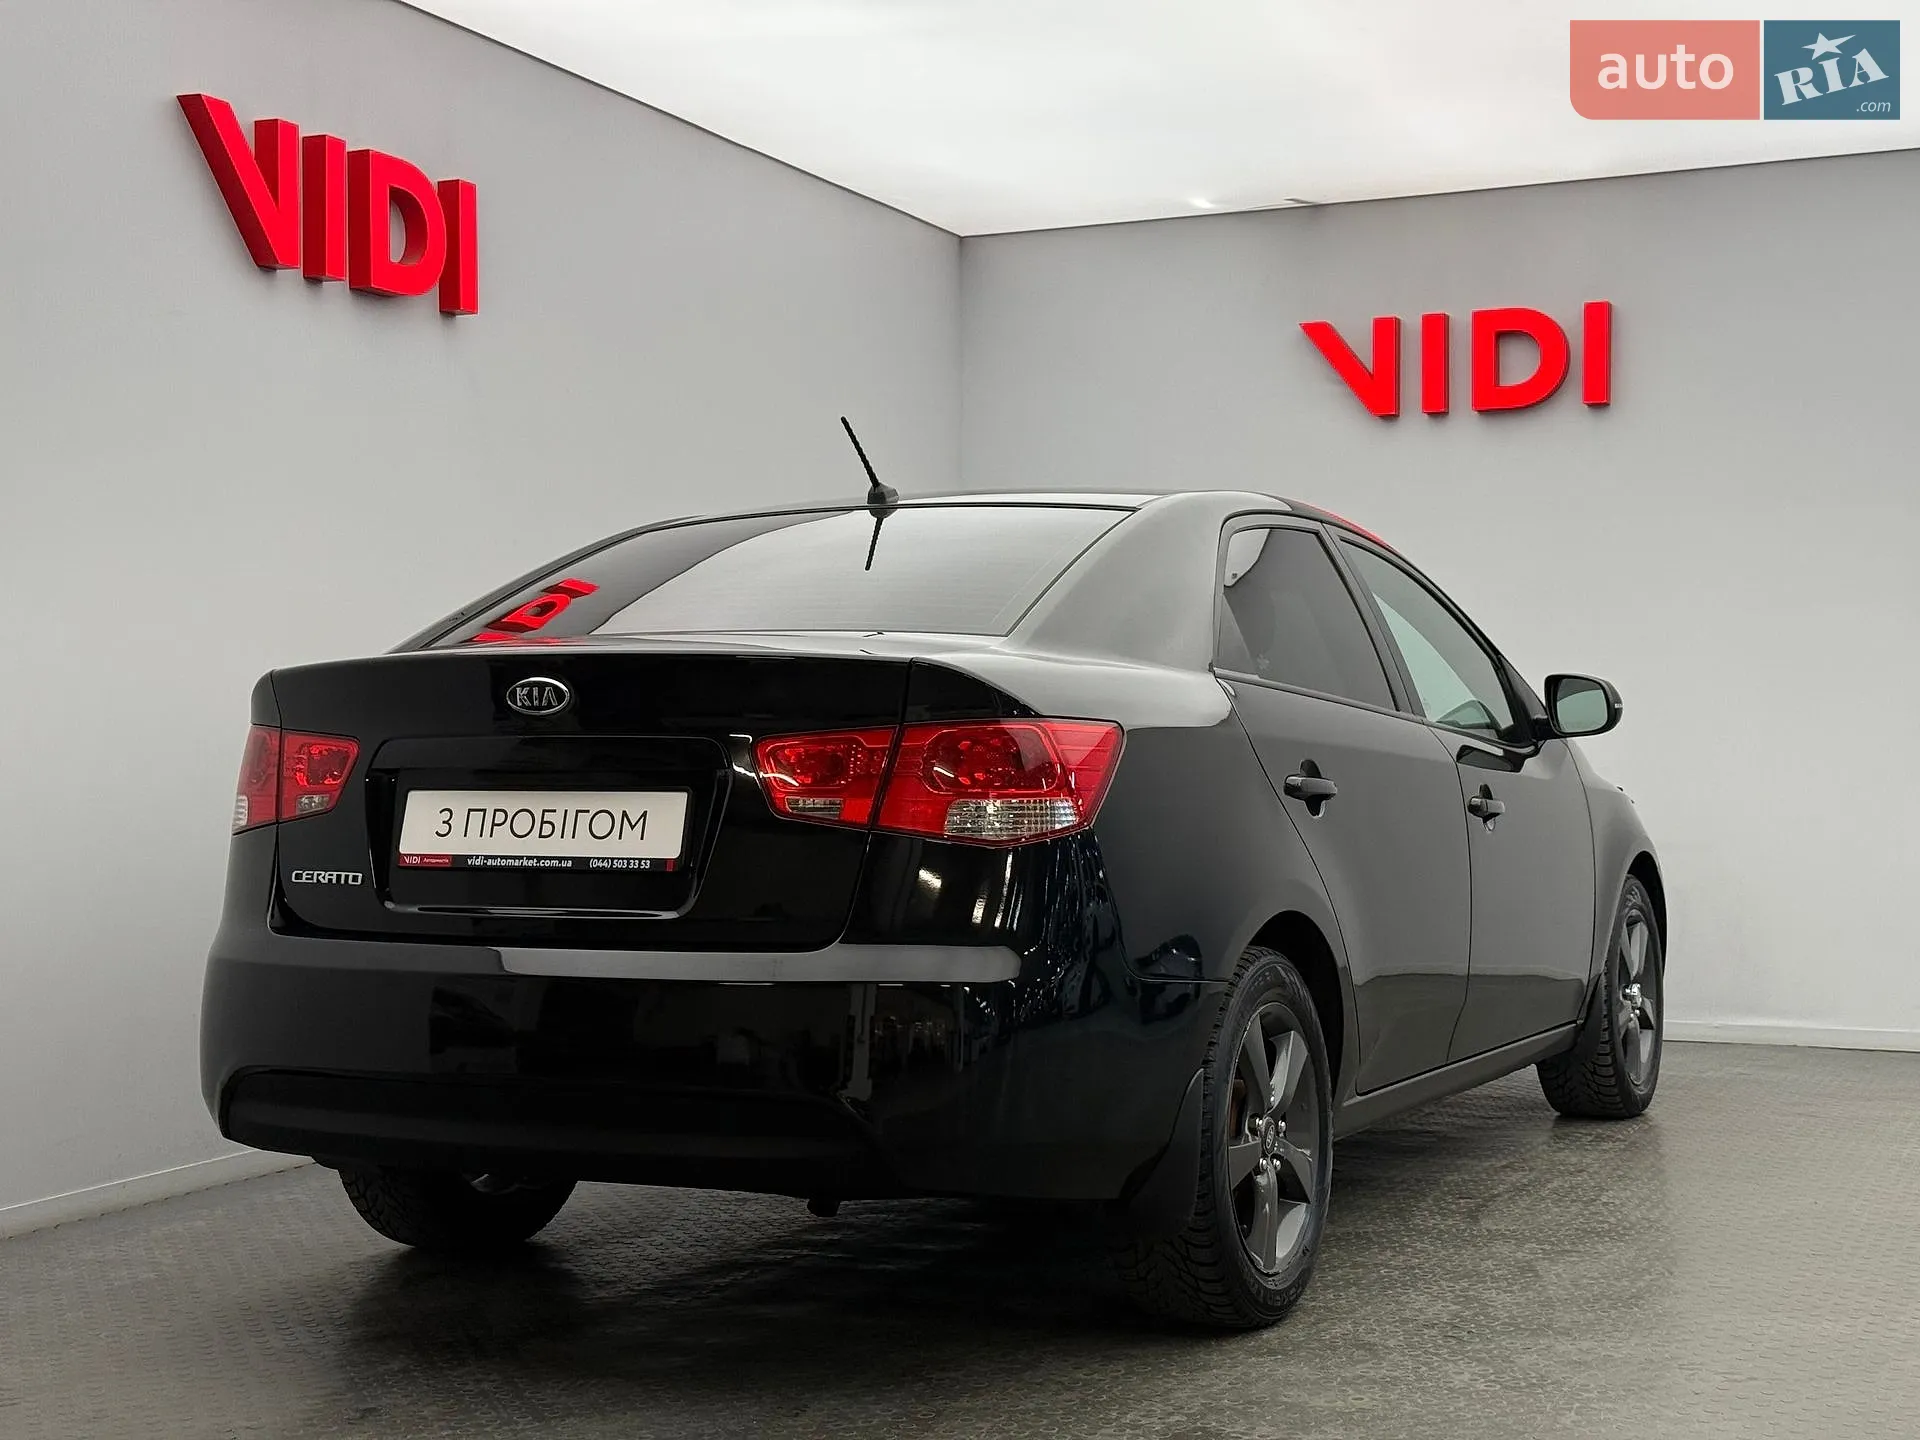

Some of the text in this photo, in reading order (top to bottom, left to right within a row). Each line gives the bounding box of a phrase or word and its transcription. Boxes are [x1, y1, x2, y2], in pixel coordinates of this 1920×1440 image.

[176, 93, 479, 316] VIDI
[1298, 300, 1613, 418] VIDI
[515, 686, 559, 707] KIA
[463, 808, 648, 841] ПРОБІГОМ
[403, 855, 421, 864] VIDI
[467, 855, 651, 869] vidi-automarket.com.ua (044) 503 33 53
[291, 870, 363, 886] CERATO
